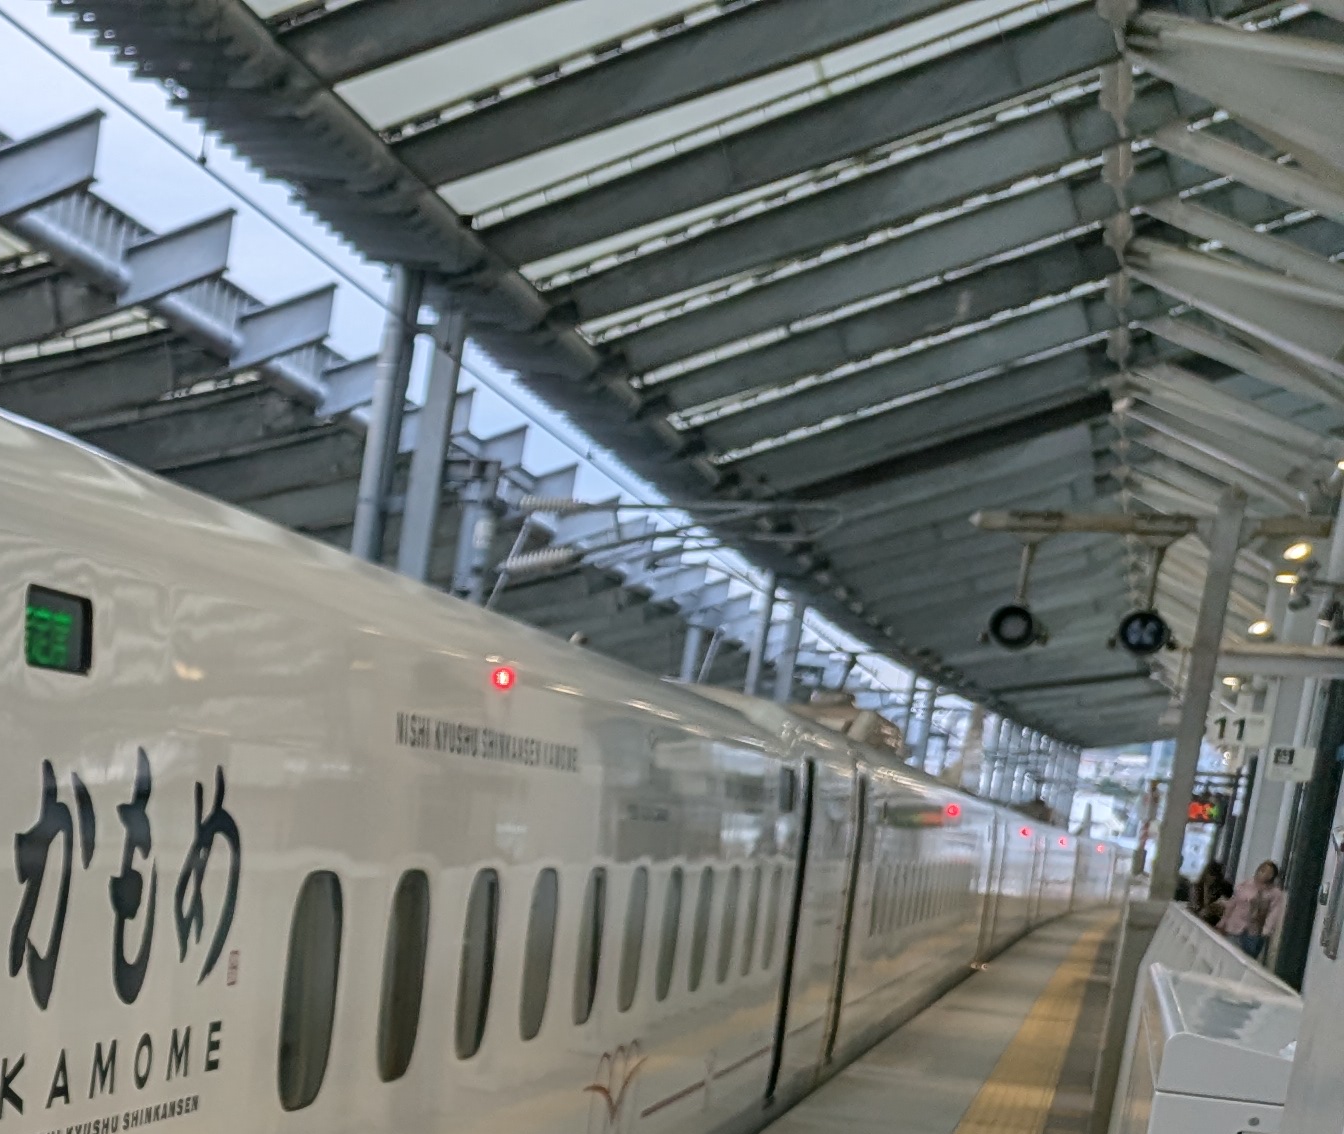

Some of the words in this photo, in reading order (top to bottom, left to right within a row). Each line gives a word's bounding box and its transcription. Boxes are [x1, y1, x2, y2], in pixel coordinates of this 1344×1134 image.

[395, 711, 430, 750] NISHI
[434, 720, 479, 758] KYUSHU
[8, 747, 243, 1011] かもめ
[122, 1094, 200, 1132] SHINKANSEN
